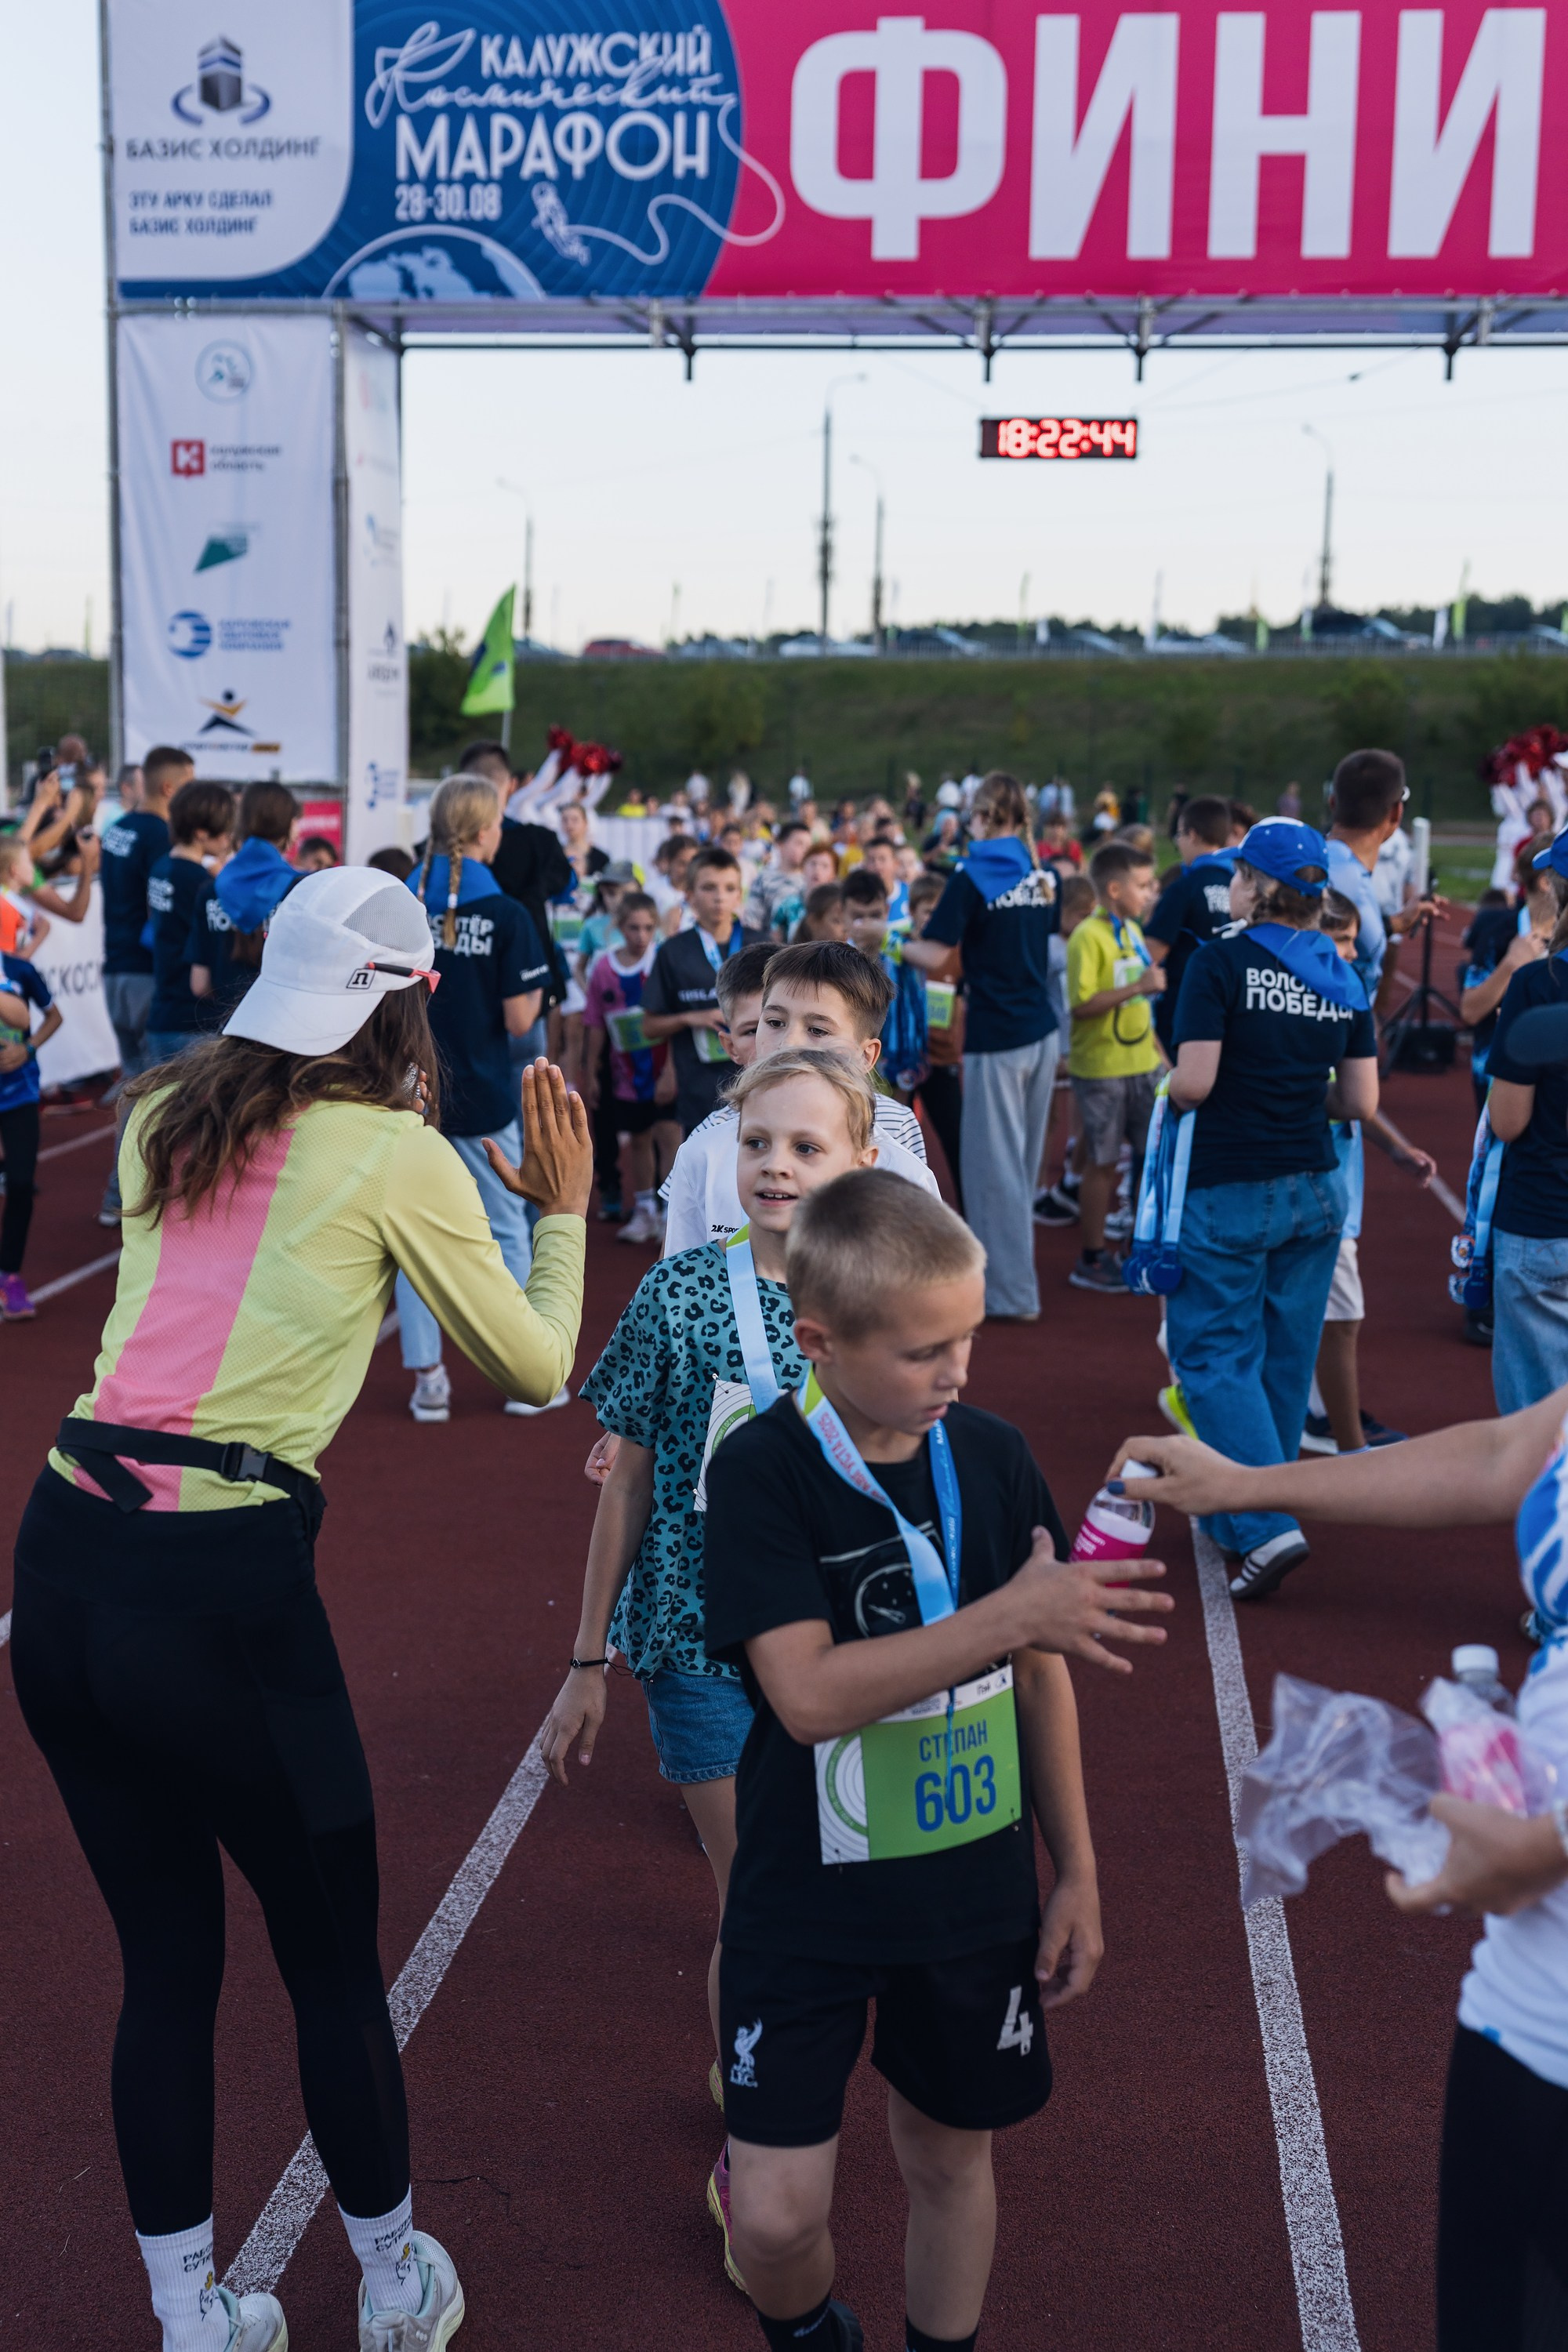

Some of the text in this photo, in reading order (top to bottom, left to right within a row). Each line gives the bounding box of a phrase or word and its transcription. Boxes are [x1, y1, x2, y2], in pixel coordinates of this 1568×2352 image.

[481, 24, 711, 78] КАЛУЖСКИЙ
[125, 136, 321, 163] БАЗИС ХОЛДИНГ
[395, 111, 710, 181] МАРАФОН
[789, 7, 1548, 261] ФИНИ
[162, 189, 205, 209] АРКУ
[207, 188, 273, 211] СДЕЛАЛ
[128, 215, 258, 236] БАЗИС ХОЛДИНГ
[997, 418, 1136, 459] 18:22:44
[1246, 967, 1313, 993] ВОЛО
[1246, 986, 1354, 1022] ПОБЕДЫ
[918, 1719, 988, 1762] СТЕПАН
[915, 1754, 997, 1833] 603
[996, 1984, 1034, 2056] 4
